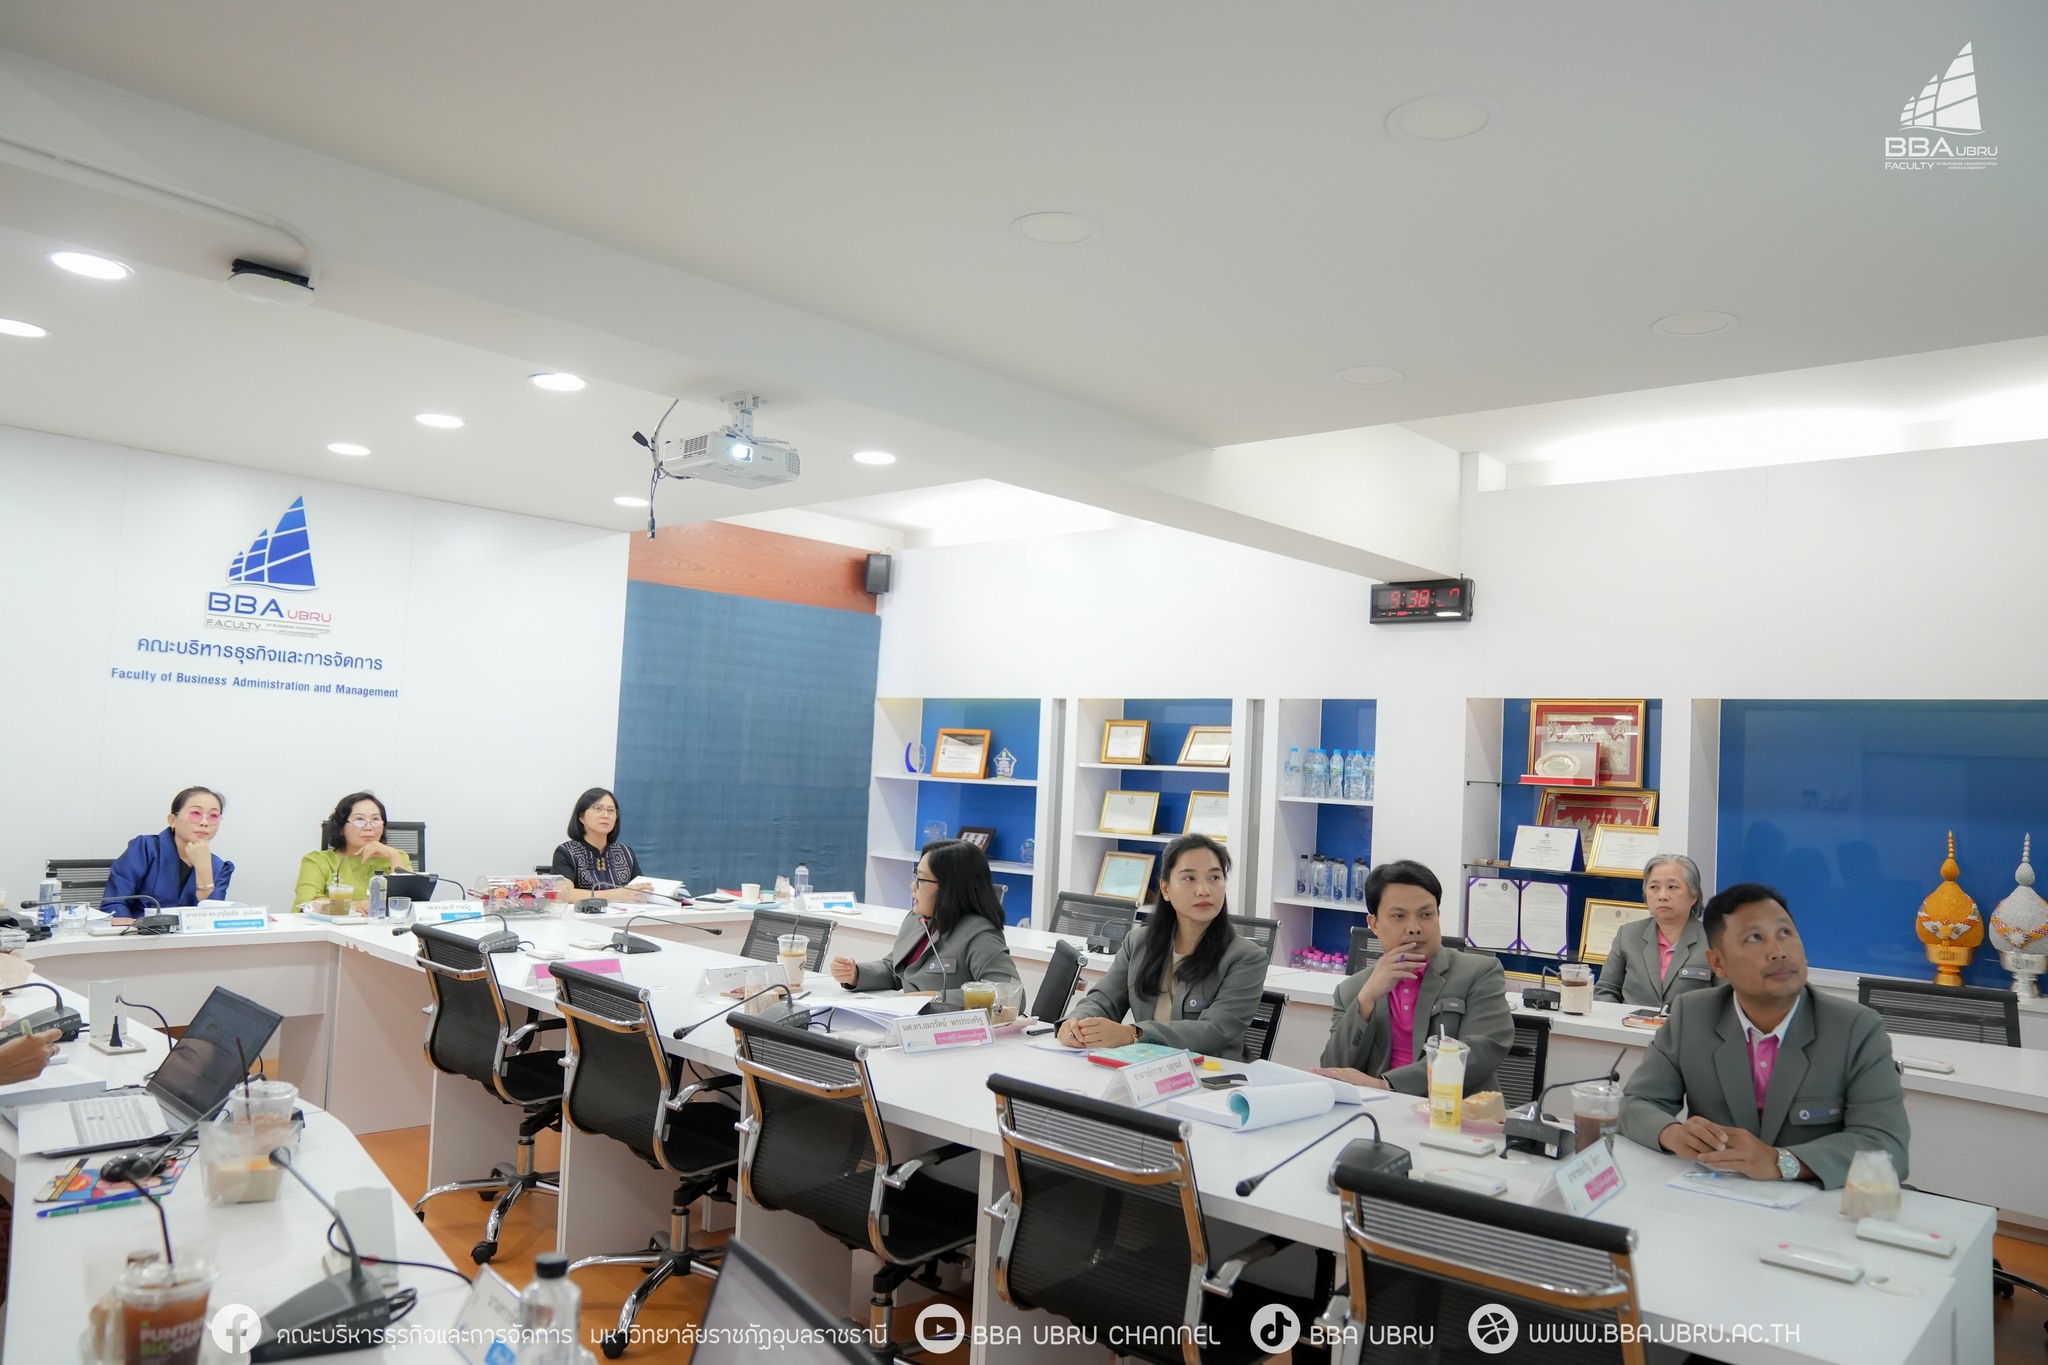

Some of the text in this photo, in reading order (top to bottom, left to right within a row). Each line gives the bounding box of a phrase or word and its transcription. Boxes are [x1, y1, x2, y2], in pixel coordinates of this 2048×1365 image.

[208, 591, 332, 622] BBA UBRU
[206, 619, 262, 631] FACULTY
[138, 638, 383, 671] คณะบริหารธุรกิจและการจัดการ
[111, 667, 399, 698] Faculty of Business Administration and Management
